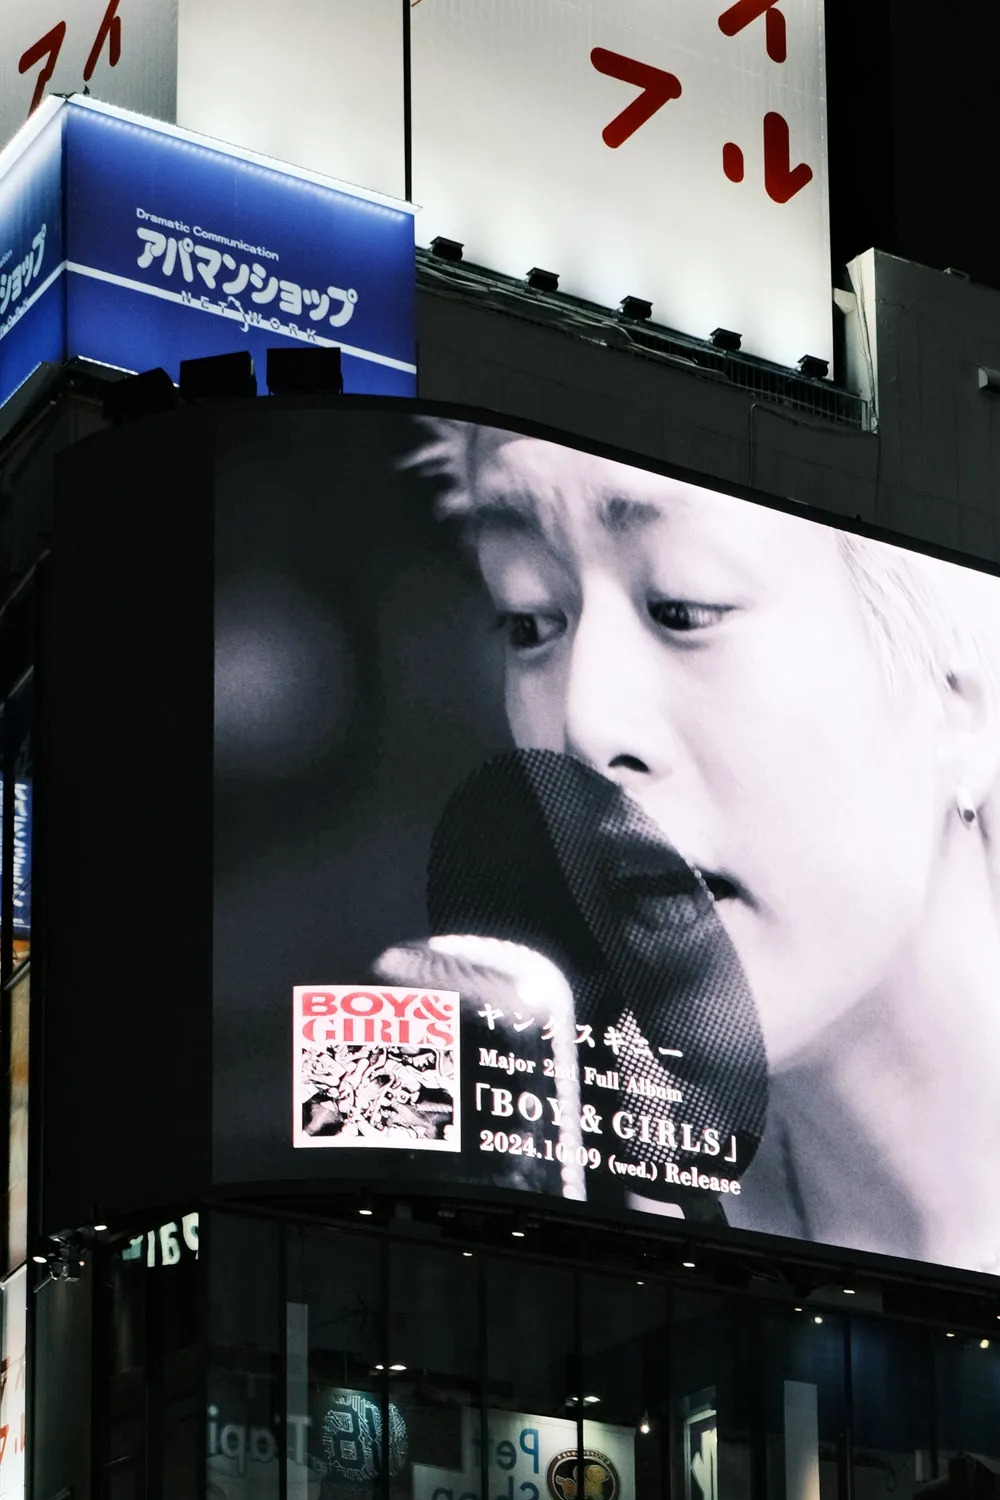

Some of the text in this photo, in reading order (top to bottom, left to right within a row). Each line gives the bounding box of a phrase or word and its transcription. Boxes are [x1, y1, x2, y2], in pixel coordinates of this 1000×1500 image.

[136, 208, 279, 262] Dramatic Communication
[136, 227, 358, 328] アパマンショップ
[302, 1017, 454, 1046] GIRLS
[479, 1049, 536, 1075] Major
[585, 1065, 620, 1090] Full
[626, 1074, 683, 1103] Album
[580, 1106, 604, 1134] &
[479, 1130, 742, 1196] 2024.1009 (wed.) Release
